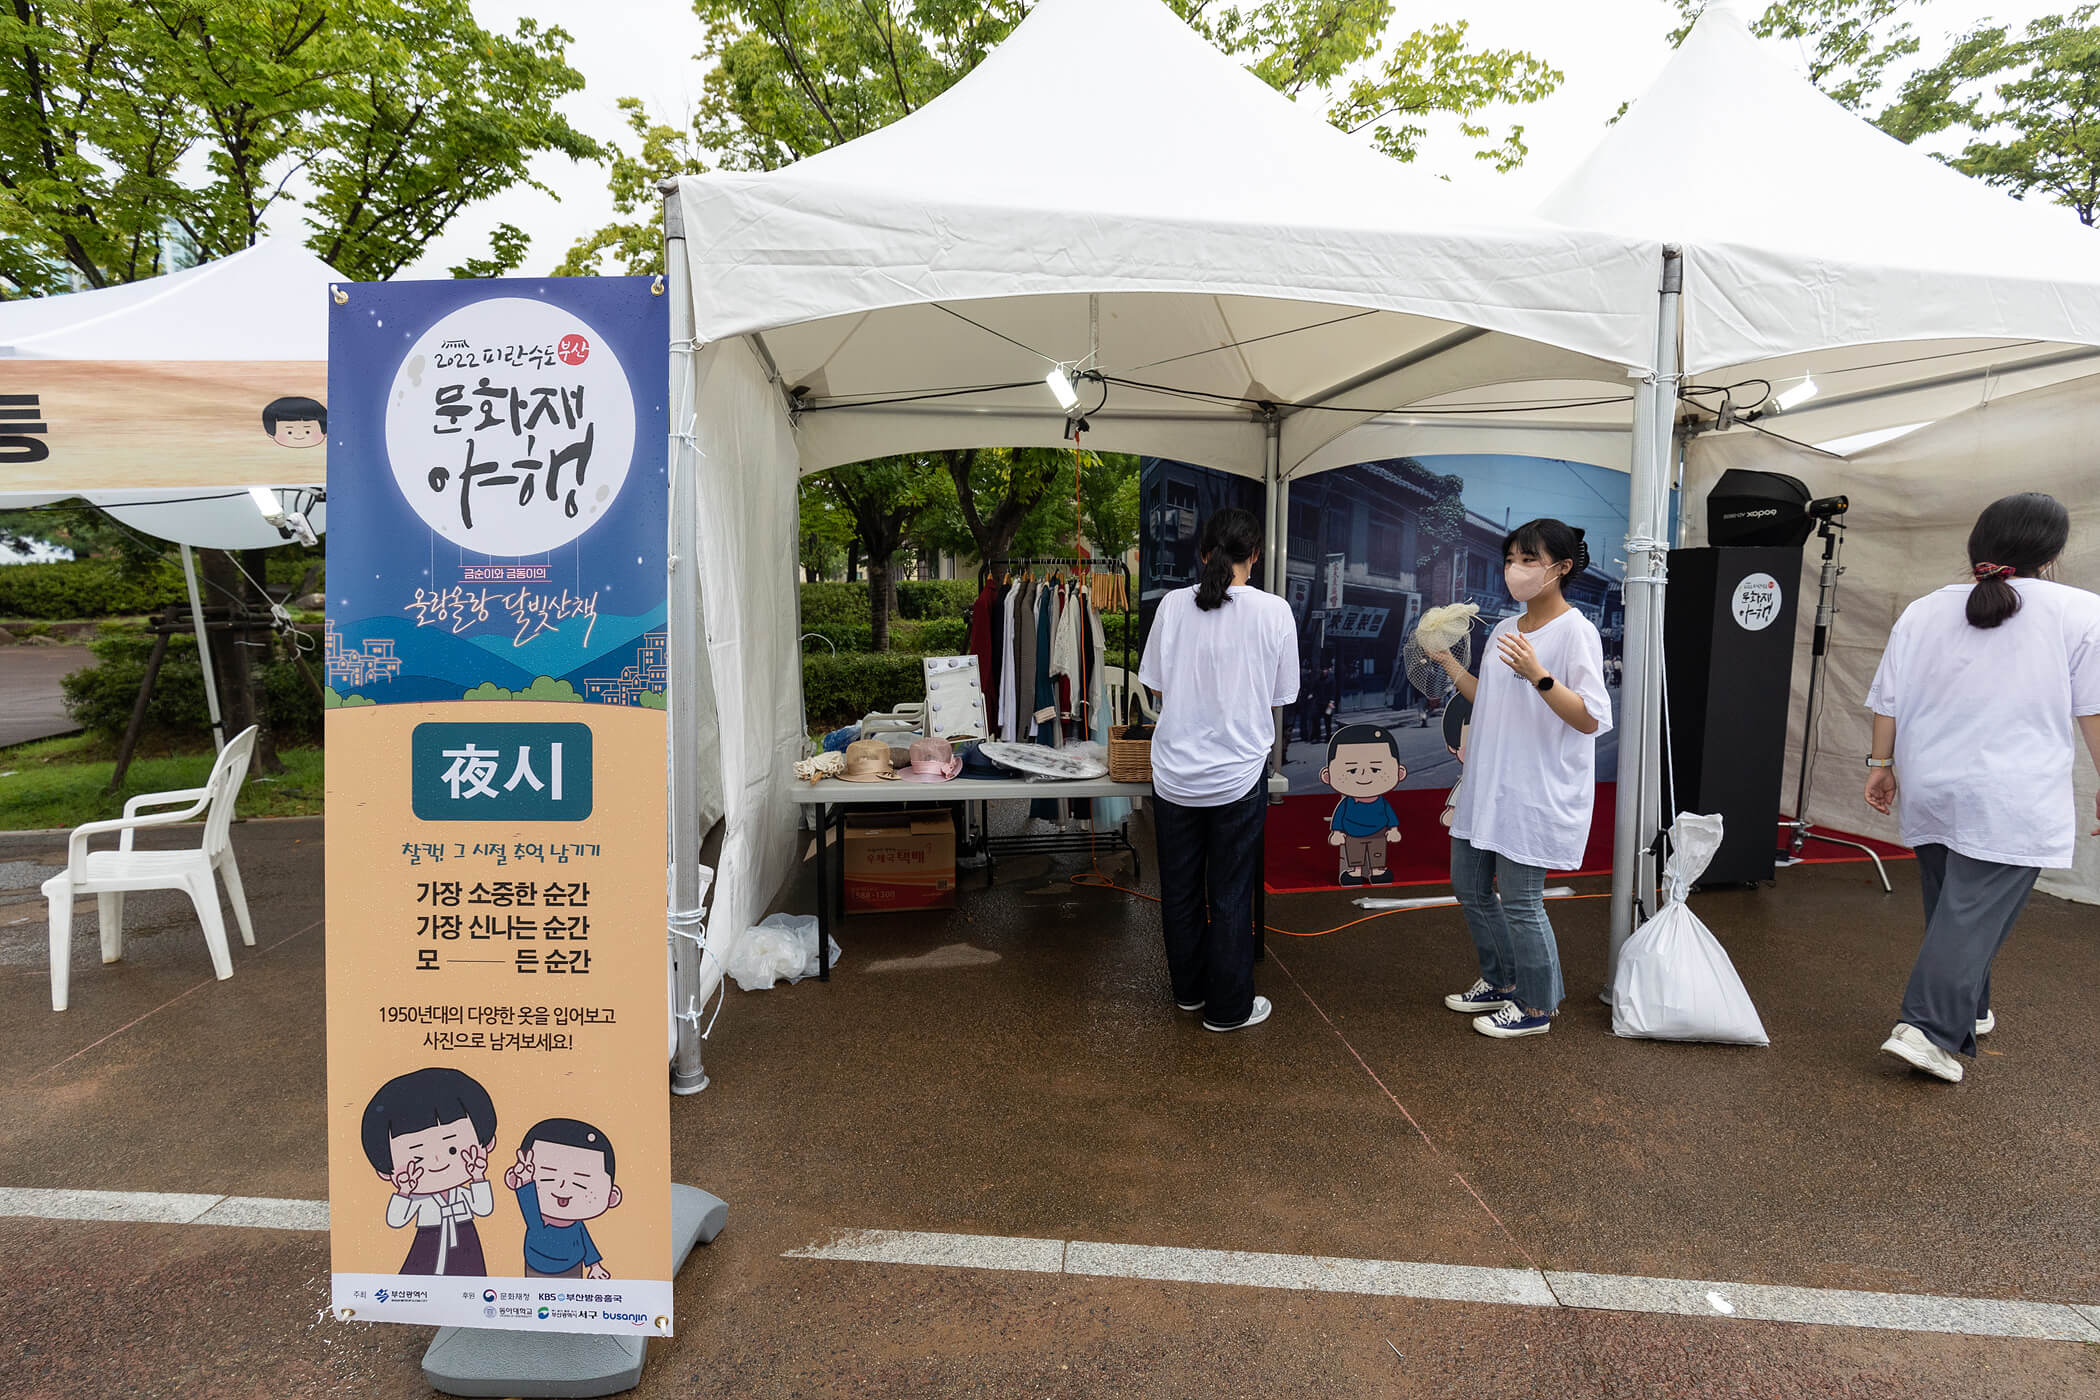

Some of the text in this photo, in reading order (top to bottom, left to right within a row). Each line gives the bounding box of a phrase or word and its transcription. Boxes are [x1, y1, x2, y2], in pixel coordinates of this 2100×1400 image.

[434, 340, 590, 370] 2022 피란수도 부산
[433, 377, 585, 436] 문화재
[428, 422, 594, 529] 야행
[464, 568, 546, 580] 금순이와 금동이의
[502, 586, 598, 648] 달빛산책
[440, 742, 563, 800] 夜시
[454, 843, 465, 858] 그
[473, 843, 507, 866] 시절
[514, 843, 544, 863] 추억
[550, 843, 600, 863] 남기기
[416, 881, 590, 908] 가장 소중한 순간
[416, 915, 590, 941] 가장 신나는 순간
[544, 950, 591, 974] 순간
[379, 1006, 617, 1026] 1950년대의 다양한 옷을 입어보고
[423, 1031, 573, 1052] 사진으로 남겨보세요!
[391, 1291, 428, 1299] 부산광역시
[500, 1292, 530, 1301] 문화재청
[538, 1293, 557, 1301] KBS
[578, 1310, 598, 1319] 서구
[603, 1311, 648, 1323] busanjin
